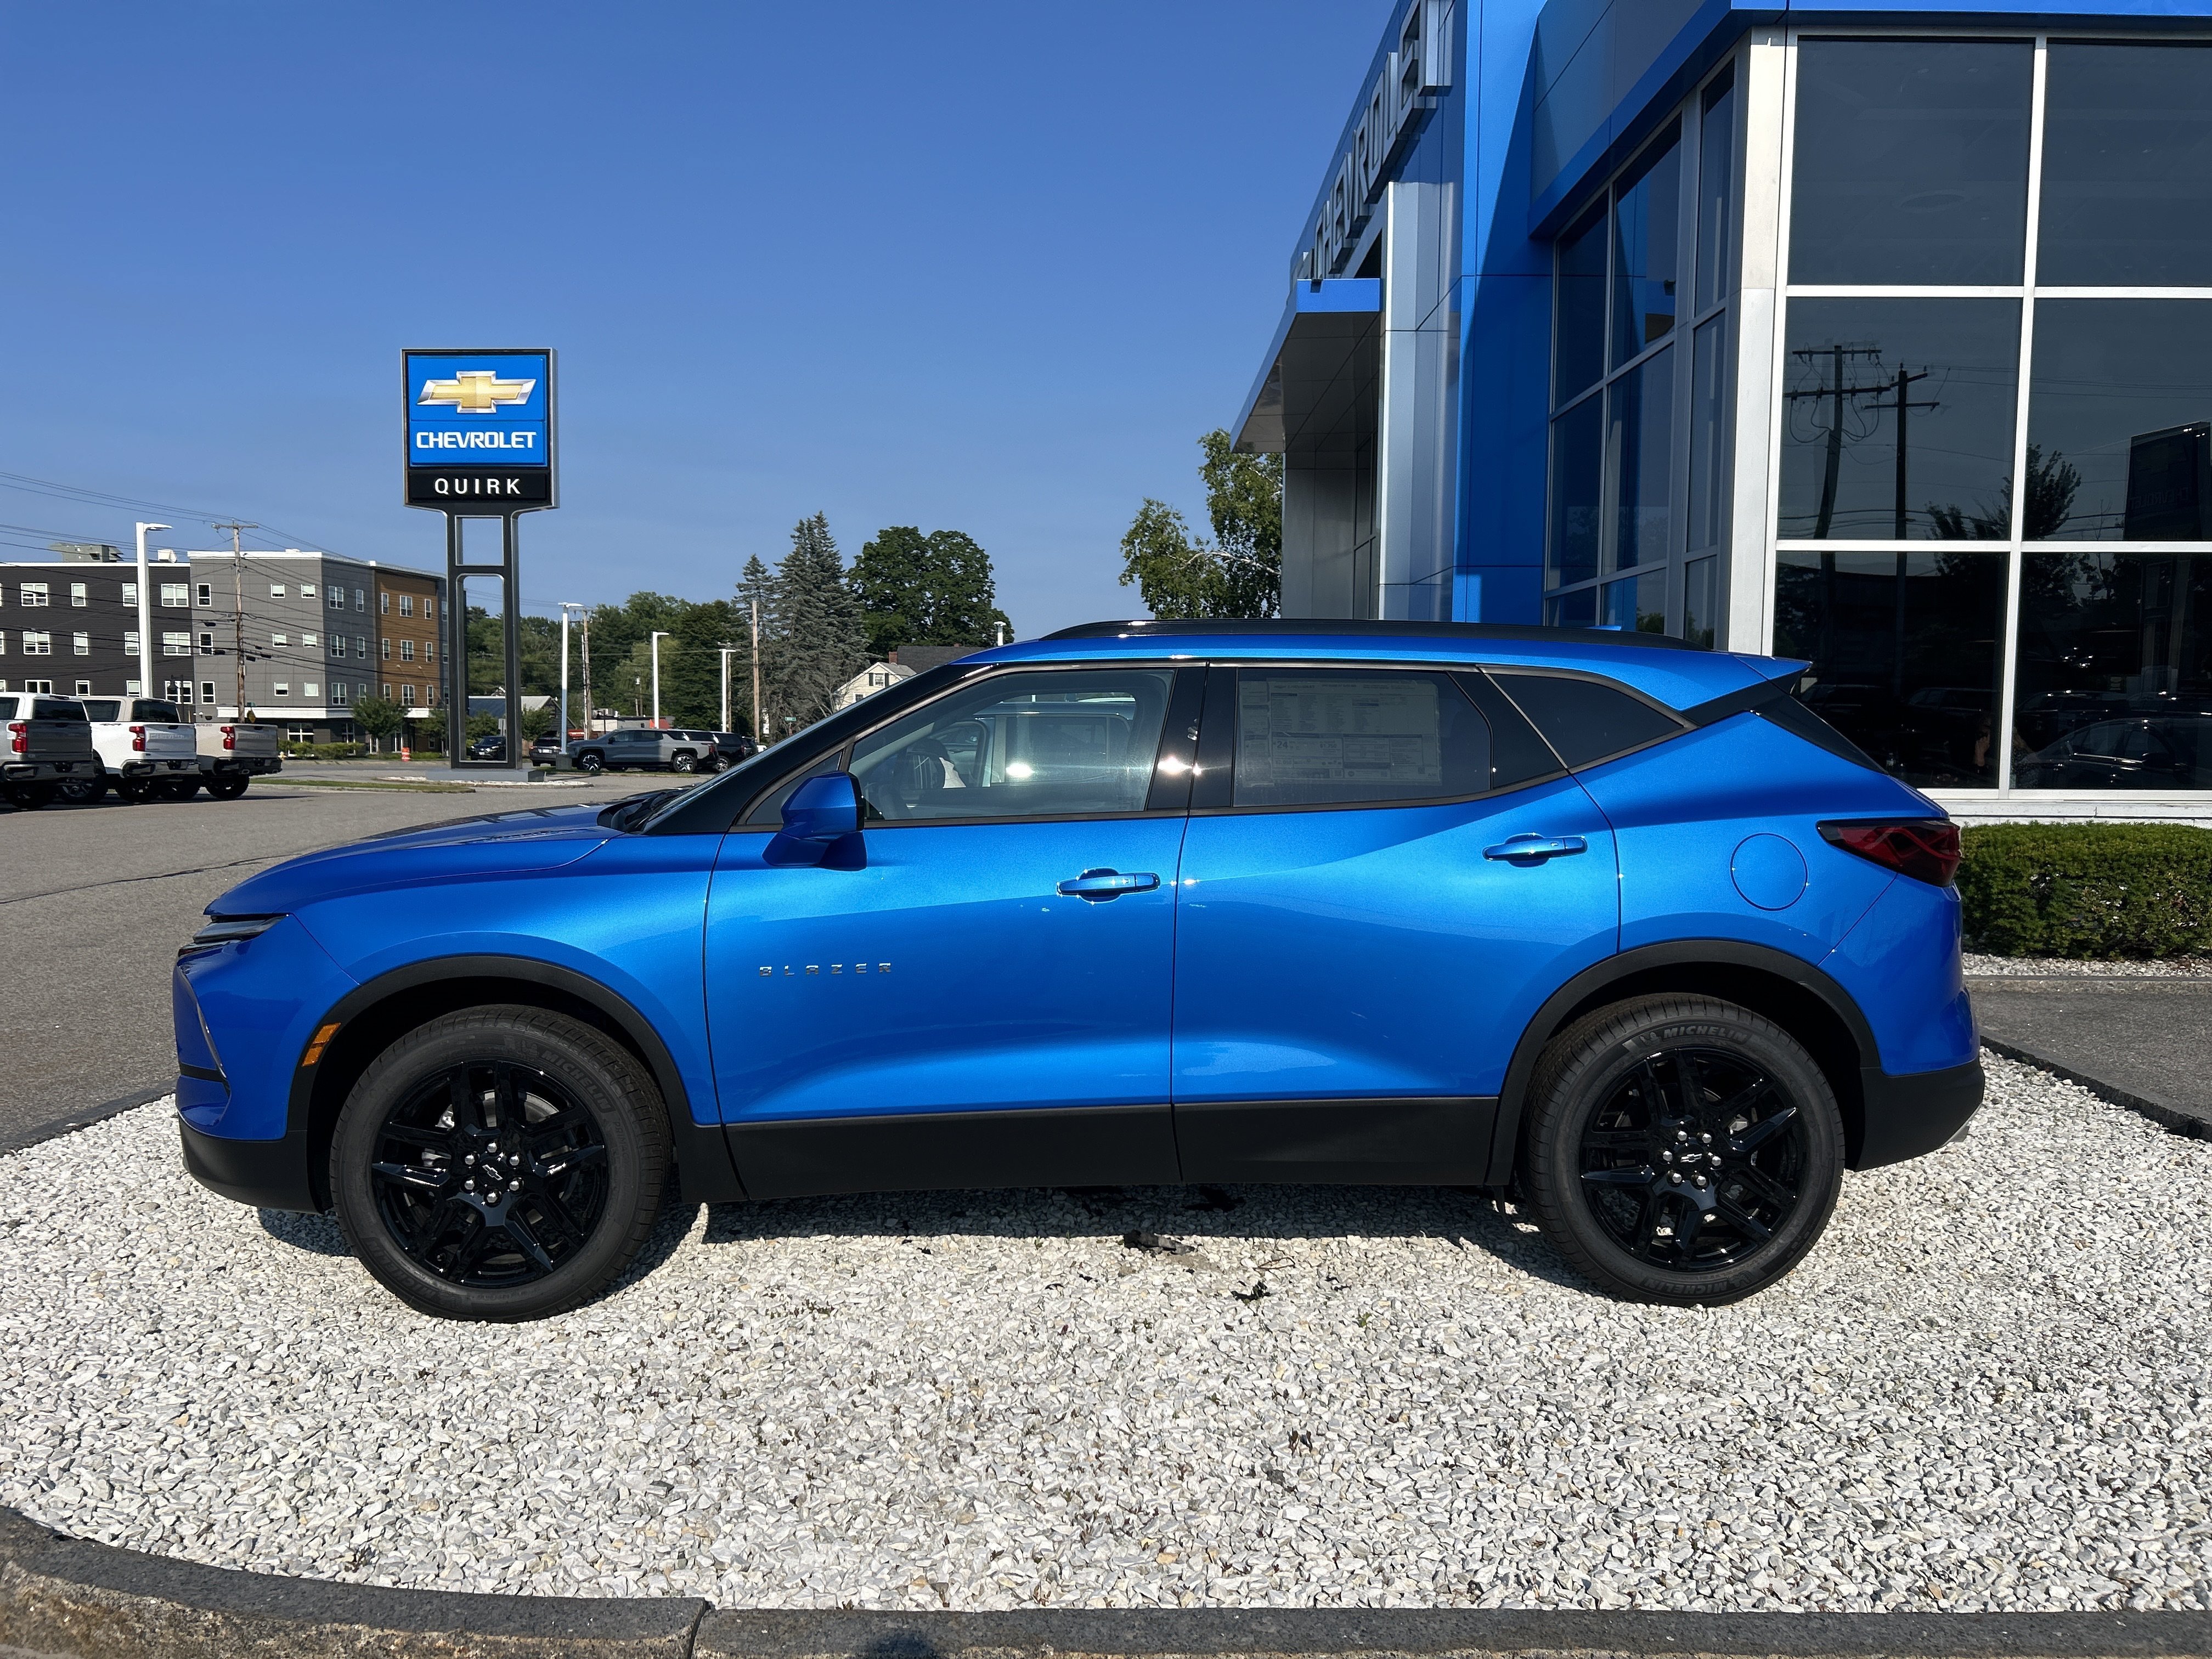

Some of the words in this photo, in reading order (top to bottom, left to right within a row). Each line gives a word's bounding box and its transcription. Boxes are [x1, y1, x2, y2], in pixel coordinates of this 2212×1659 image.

[416, 431, 538, 449] CHEVROLET
[435, 478, 521, 495] QUIRK
[759, 962, 892, 977] BLAZER
[1663, 1025, 1747, 1042] MICHELIN
[541, 1050, 613, 1110] MICHELIN
[1643, 1278, 1728, 1295] MICHELIN
